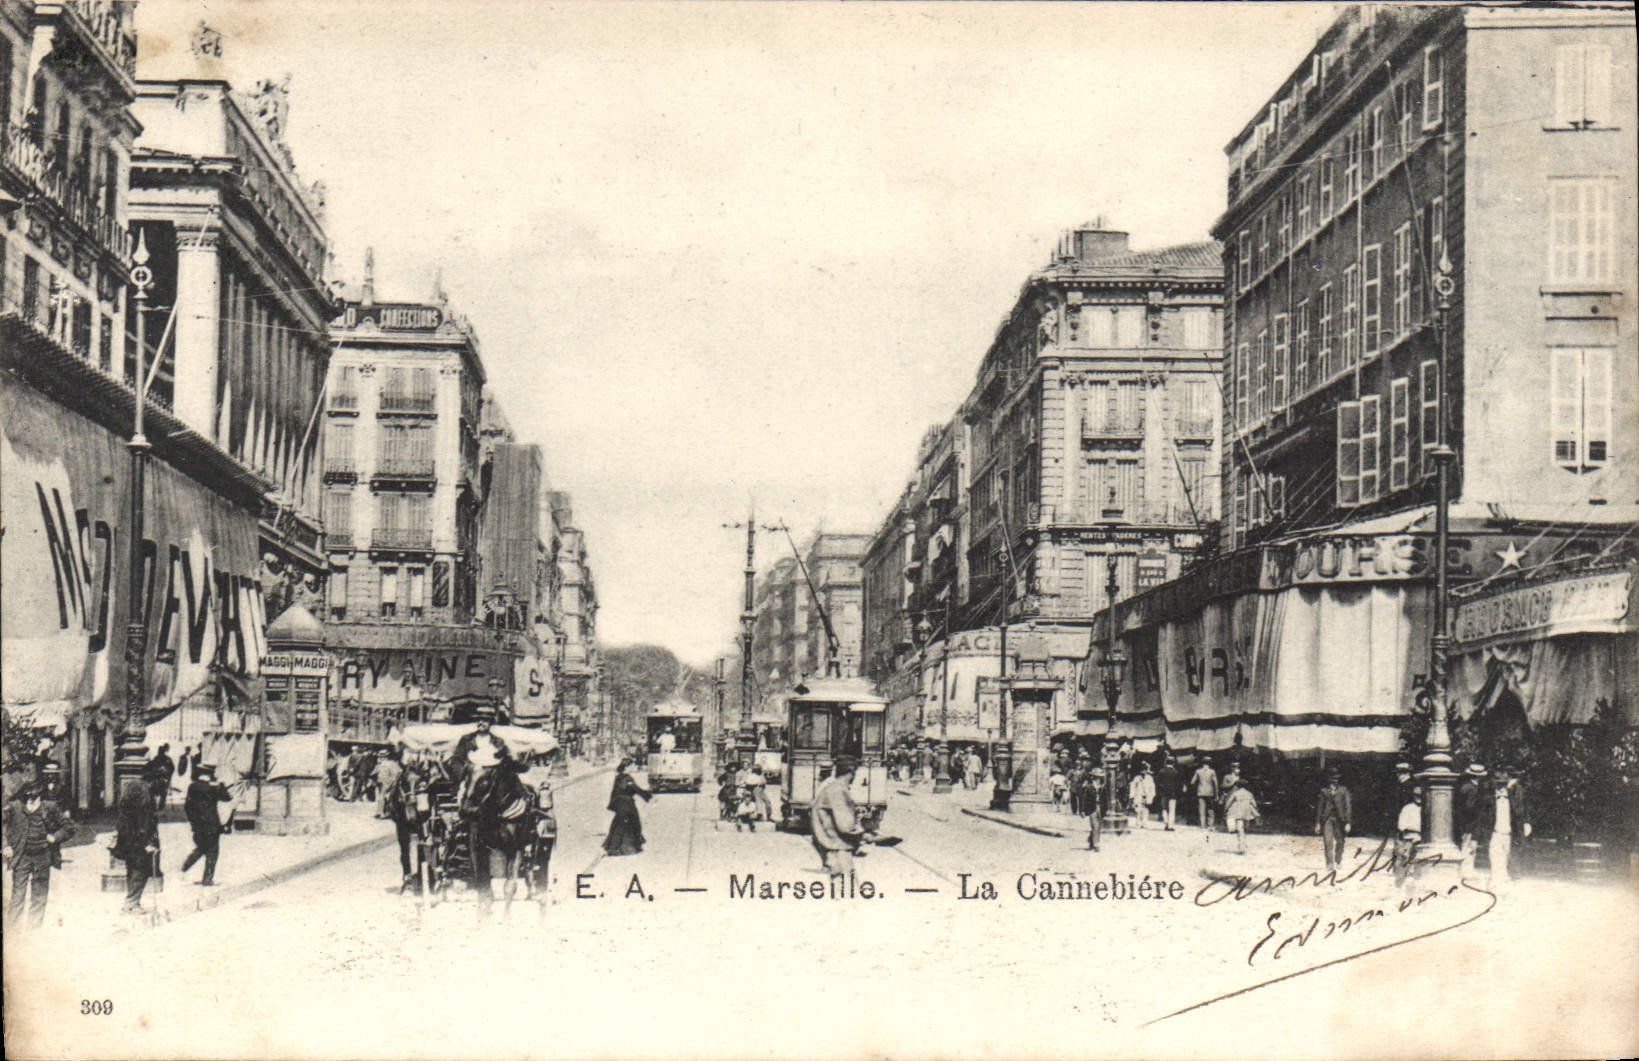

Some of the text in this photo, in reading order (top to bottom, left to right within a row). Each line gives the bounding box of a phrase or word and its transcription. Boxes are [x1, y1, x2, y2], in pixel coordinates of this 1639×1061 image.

[1262, 537, 1473, 588] OURSE
[260, 656, 290, 669] MAGGI
[294, 657, 328, 670] MAGGI
